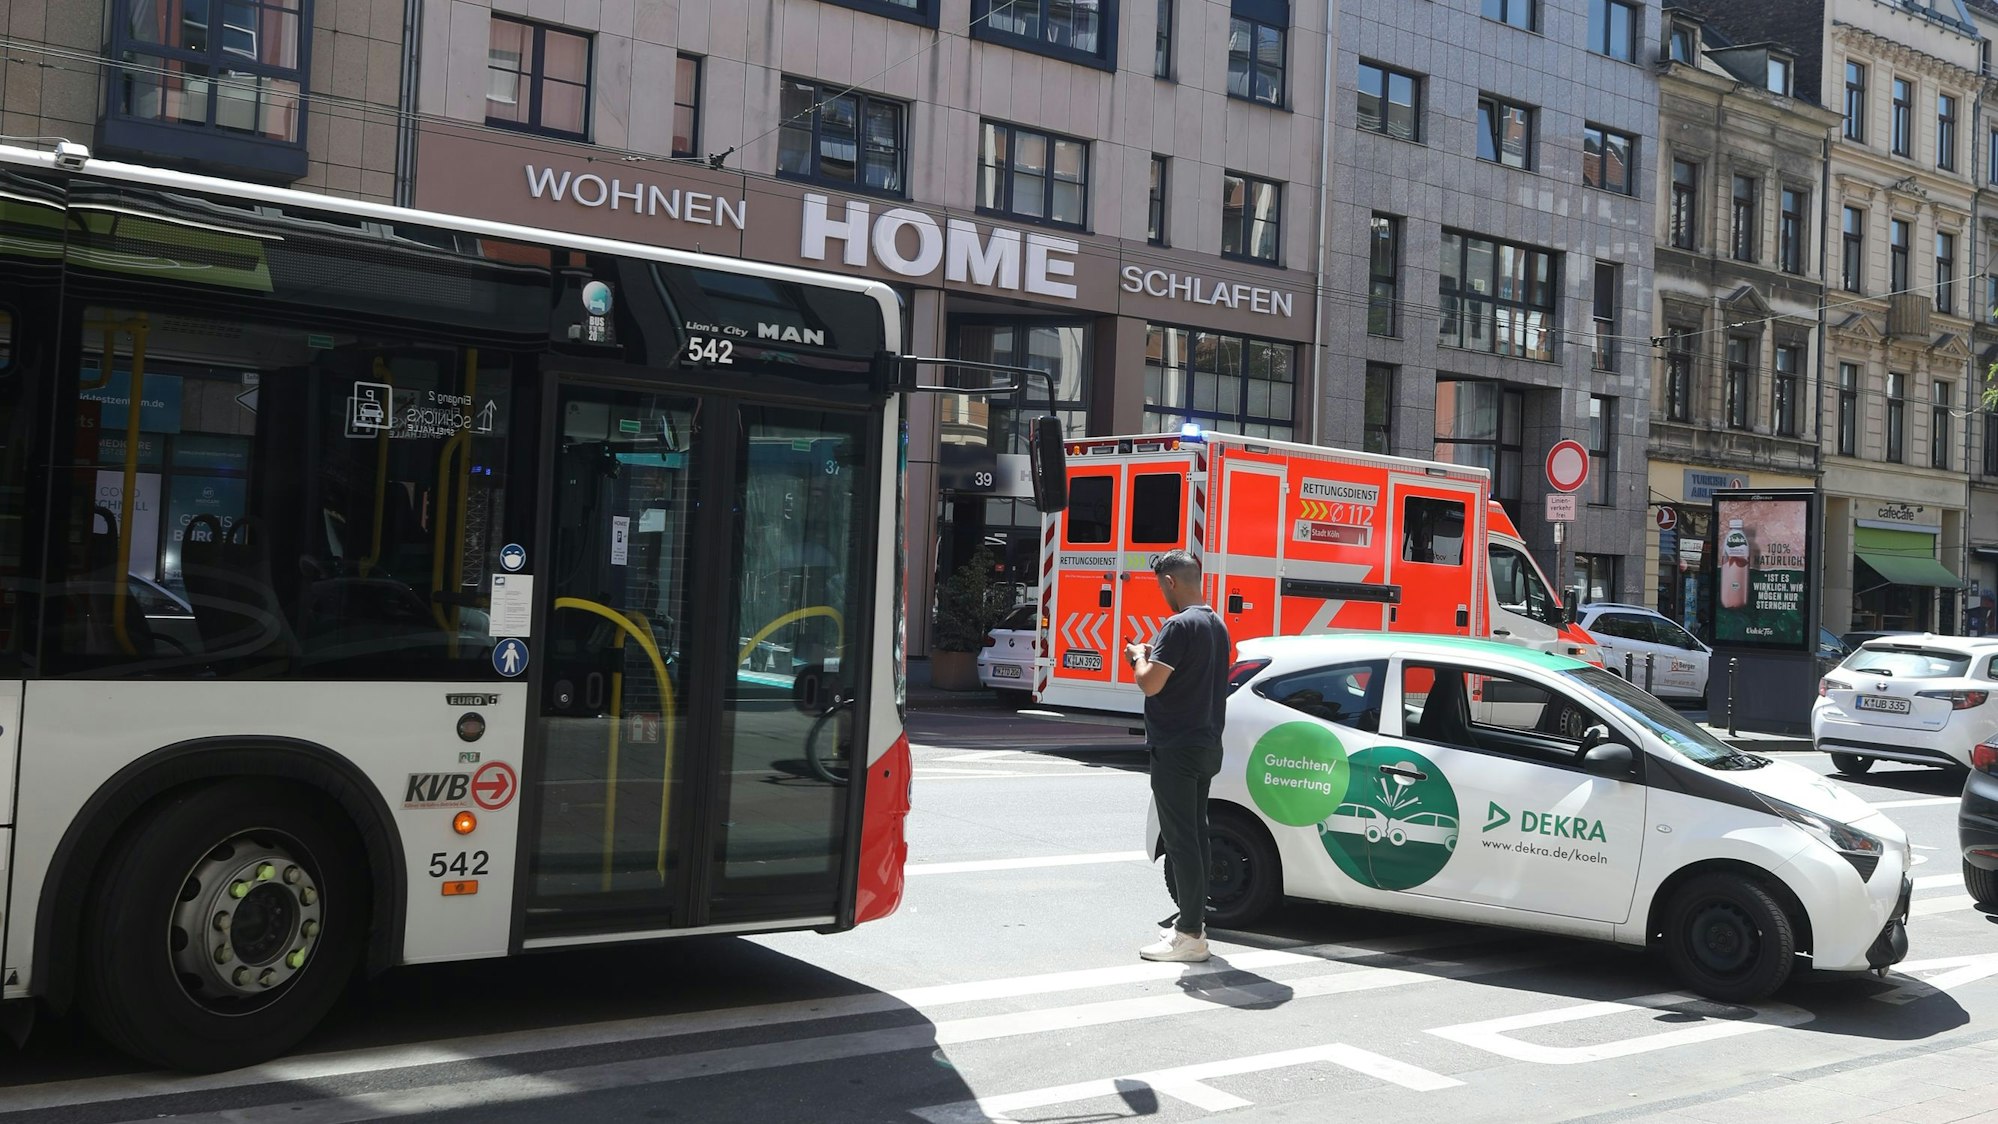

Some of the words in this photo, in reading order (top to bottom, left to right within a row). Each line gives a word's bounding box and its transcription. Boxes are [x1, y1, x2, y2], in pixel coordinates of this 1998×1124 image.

[524, 163, 746, 231] WOHNEN
[800, 193, 1079, 300] HOME
[1121, 265, 1293, 318] SCHLAFEN
[589, 315, 605, 327] BUS
[686, 320, 720, 334] Lion's
[722, 325, 748, 339] City
[757, 322, 825, 346] MAN
[687, 337, 734, 364] 542
[974, 471, 993, 487] 39
[1691, 474, 1727, 487] TURKISH
[100, 486, 141, 497] COVD
[1303, 483, 1378, 501] RETTUNGSDIENST
[1348, 504, 1374, 526] 112
[1878, 505, 1914, 521] cafecafe
[1311, 528, 1326, 537] Stadt
[1327, 530, 1340, 538] Köln
[1767, 544, 1791, 554] 100%
[1060, 556, 1115, 566] RETTUNGSDIENST
[1780, 574, 1790, 583] ES
[1753, 582, 1789, 591] WIRKLICH.
[1790, 583, 1804, 592] WIR
[1757, 591, 1782, 600] MÖGEN
[1783, 593, 1799, 601] NUR
[1755, 601, 1798, 610] STERNCHEN.
[1067, 655, 1072, 665] K
[1075, 656, 1083, 666] LN
[1085, 657, 1101, 667] 3929
[1678, 661, 1696, 670] Berger
[450, 696, 483, 705] EURO
[489, 695, 498, 705] 6
[1863, 699, 1870, 707] K
[1875, 699, 1887, 709] UB
[1888, 700, 1906, 711] 335
[1264, 752, 1336, 775] Gutachten/
[405, 774, 470, 802] KVB
[1263, 772, 1332, 794] Bewertung
[1520, 809, 1607, 843] DEKRA
[1482, 838, 1608, 865] www.dekra.de/koeln
[428, 850, 490, 878] 542
